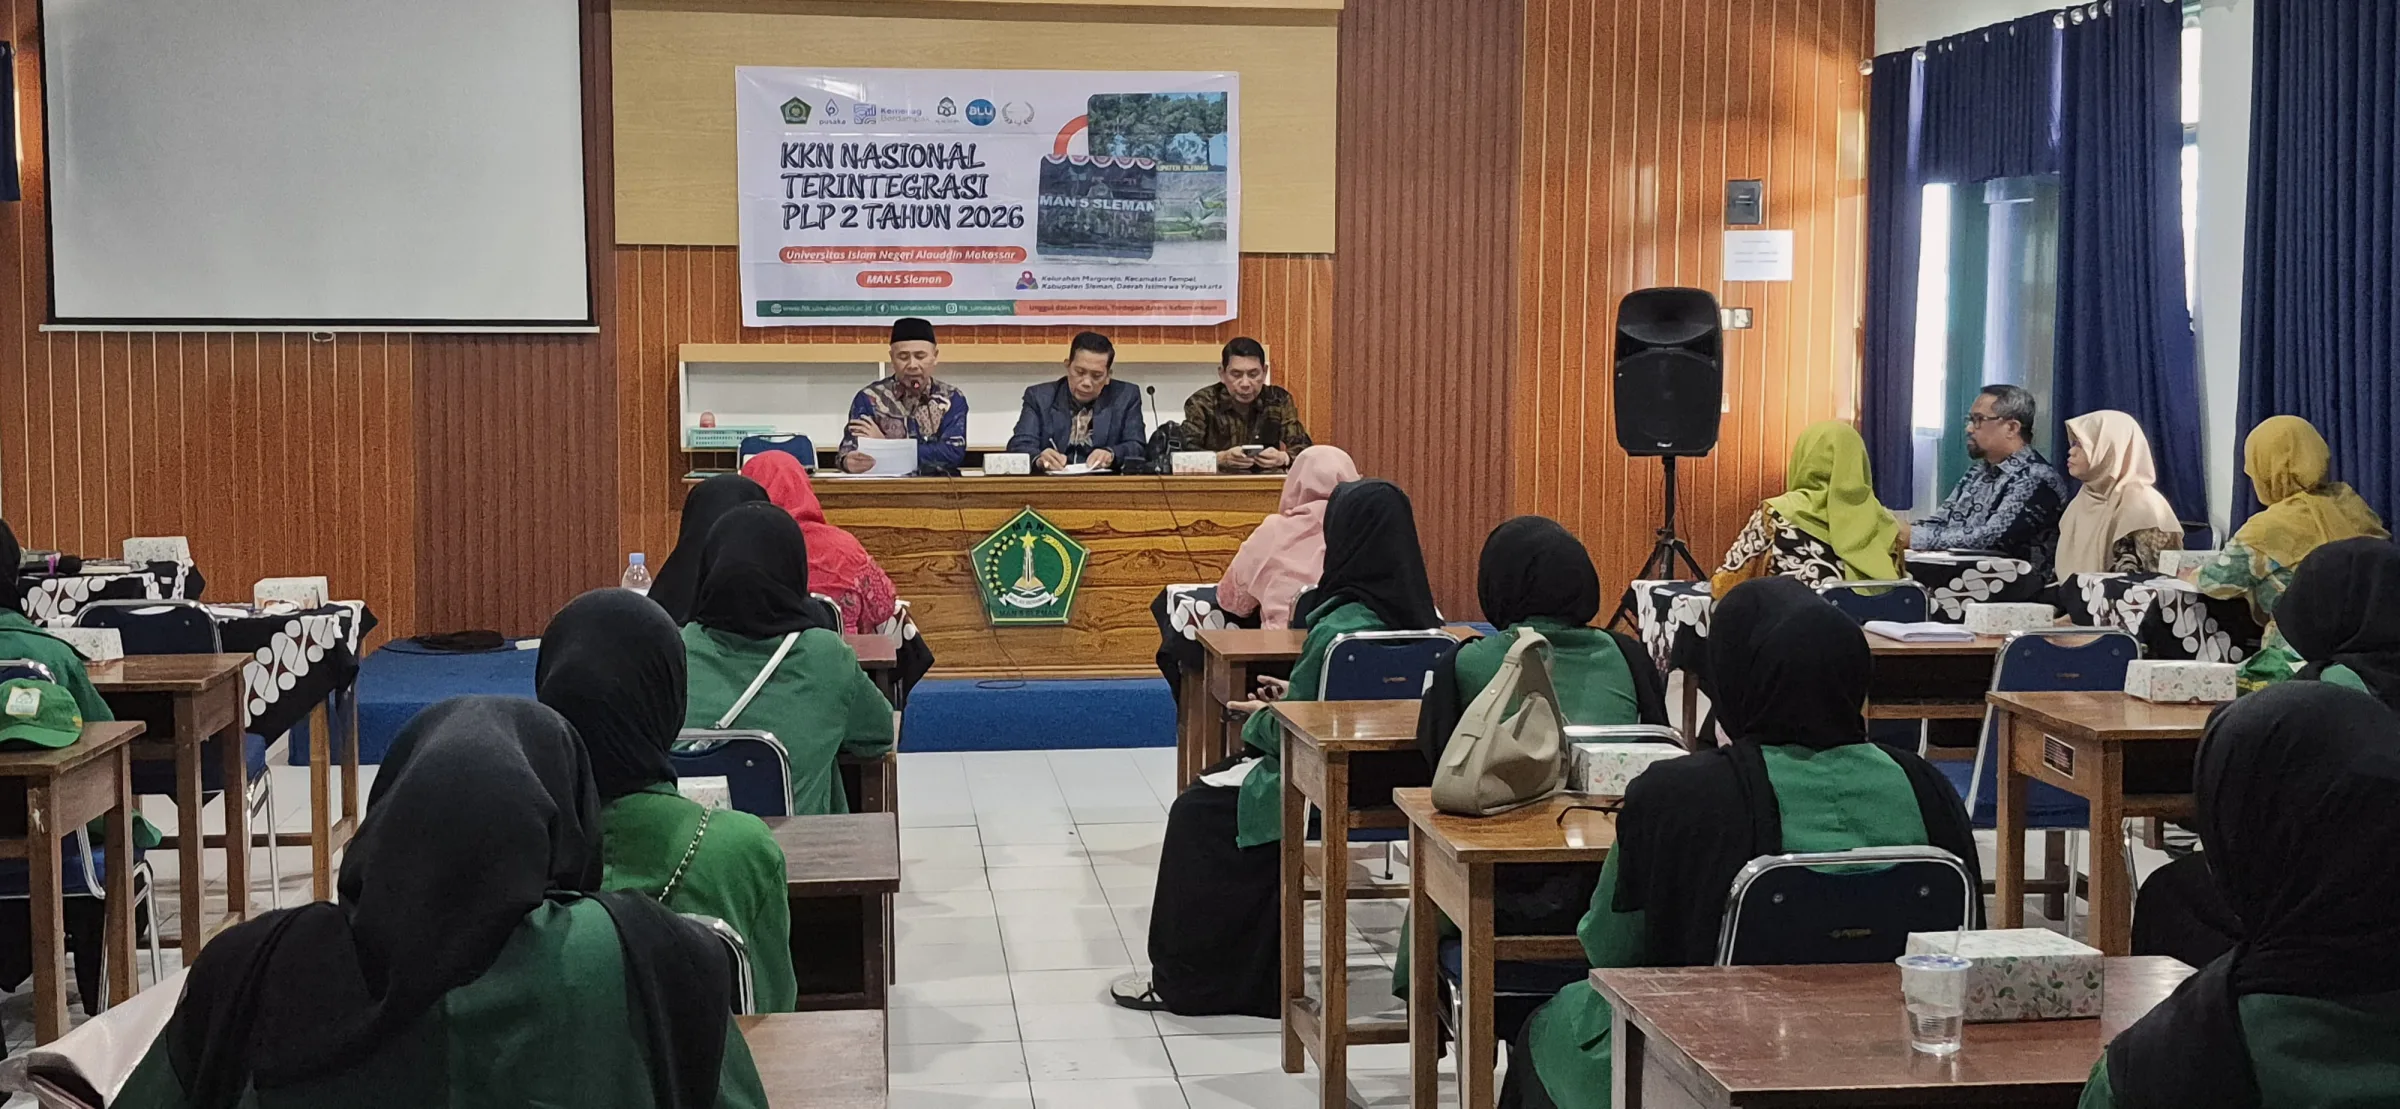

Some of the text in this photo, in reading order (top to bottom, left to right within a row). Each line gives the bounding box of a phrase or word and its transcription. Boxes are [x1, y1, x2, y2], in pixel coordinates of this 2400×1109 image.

[969, 106, 992, 116] BLU
[780, 142, 986, 170] KKN NASIONAL
[780, 173, 989, 200] TERINTEGRASI
[1040, 195, 1077, 207] MAN
[1092, 199, 1155, 212] SLEMAN
[782, 202, 1025, 230] PLP 2 TAHUN 2026
[786, 250, 846, 260] Universitas
[848, 250, 877, 260] Islam
[964, 250, 1016, 260] Makassar
[866, 274, 942, 284] MAN 5 Sleman
[1011, 521, 1045, 532] MAN
